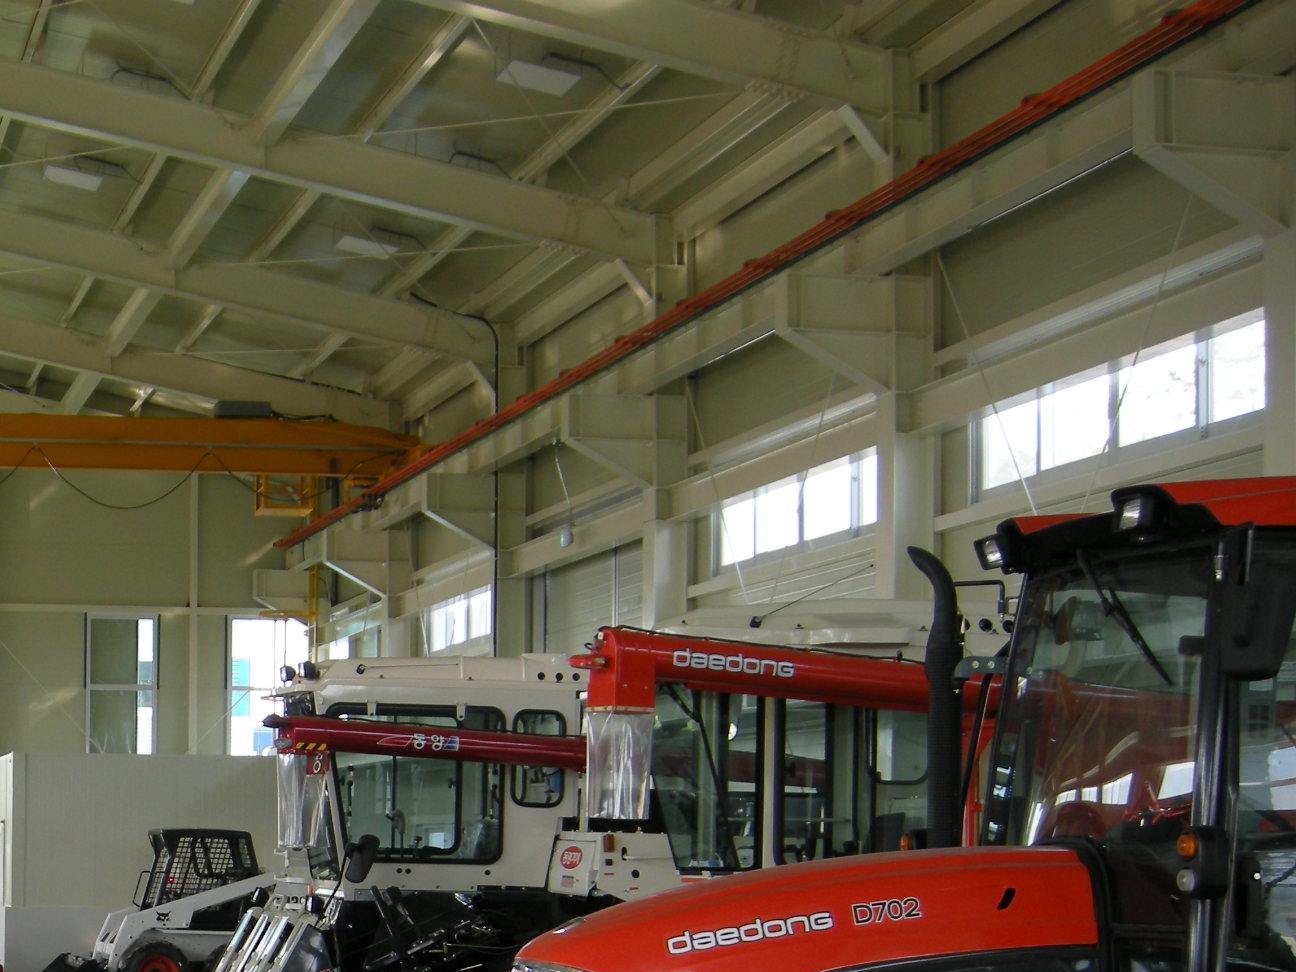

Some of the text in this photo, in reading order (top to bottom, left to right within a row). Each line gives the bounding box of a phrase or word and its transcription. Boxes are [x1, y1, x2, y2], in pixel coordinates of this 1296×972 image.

[672, 648, 795, 678] daedong
[412, 733, 445, 751] 동양
[666, 897, 922, 955] daedong D702
